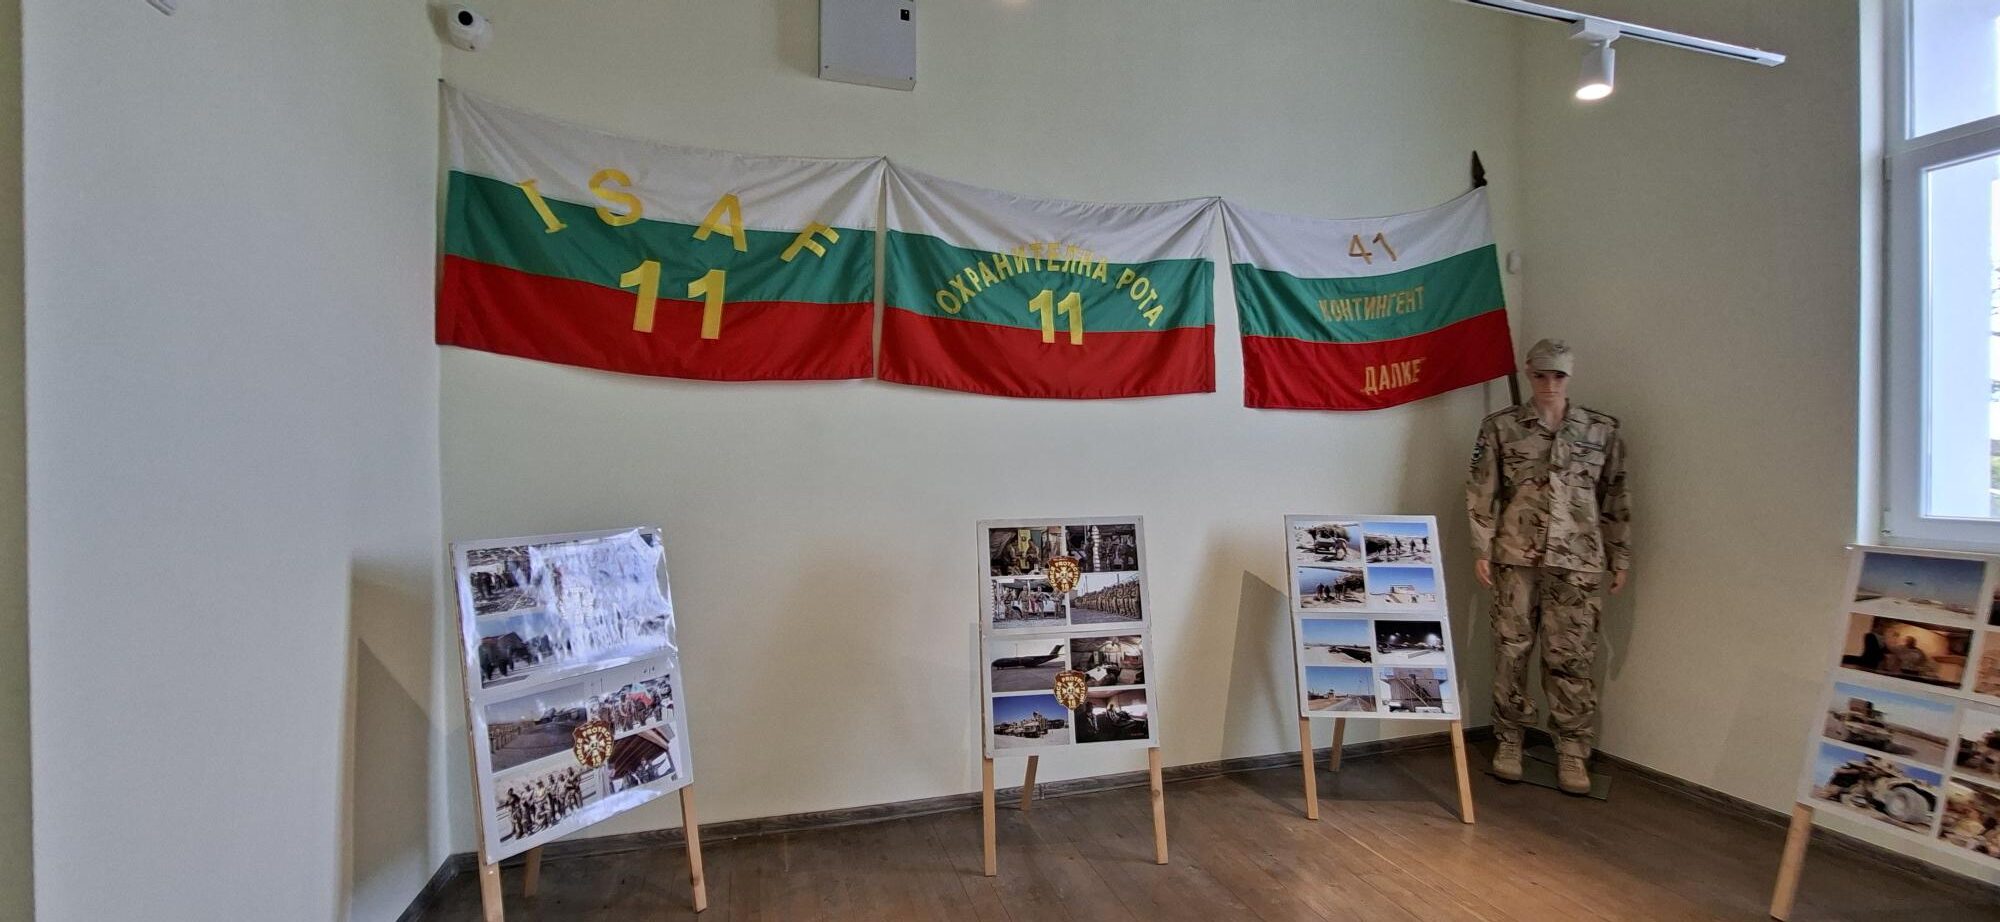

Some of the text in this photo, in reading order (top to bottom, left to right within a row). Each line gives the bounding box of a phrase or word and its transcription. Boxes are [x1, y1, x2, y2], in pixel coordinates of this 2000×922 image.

[517, 168, 839, 262] ISAF
[1349, 232, 1397, 265] 41
[619, 260, 726, 340] 11
[936, 242, 1164, 327] ОХРАНИТЕЛНА РОТА
[1029, 289, 1083, 346] 11
[1318, 286, 1424, 322] КОНТИНГЕНТ
